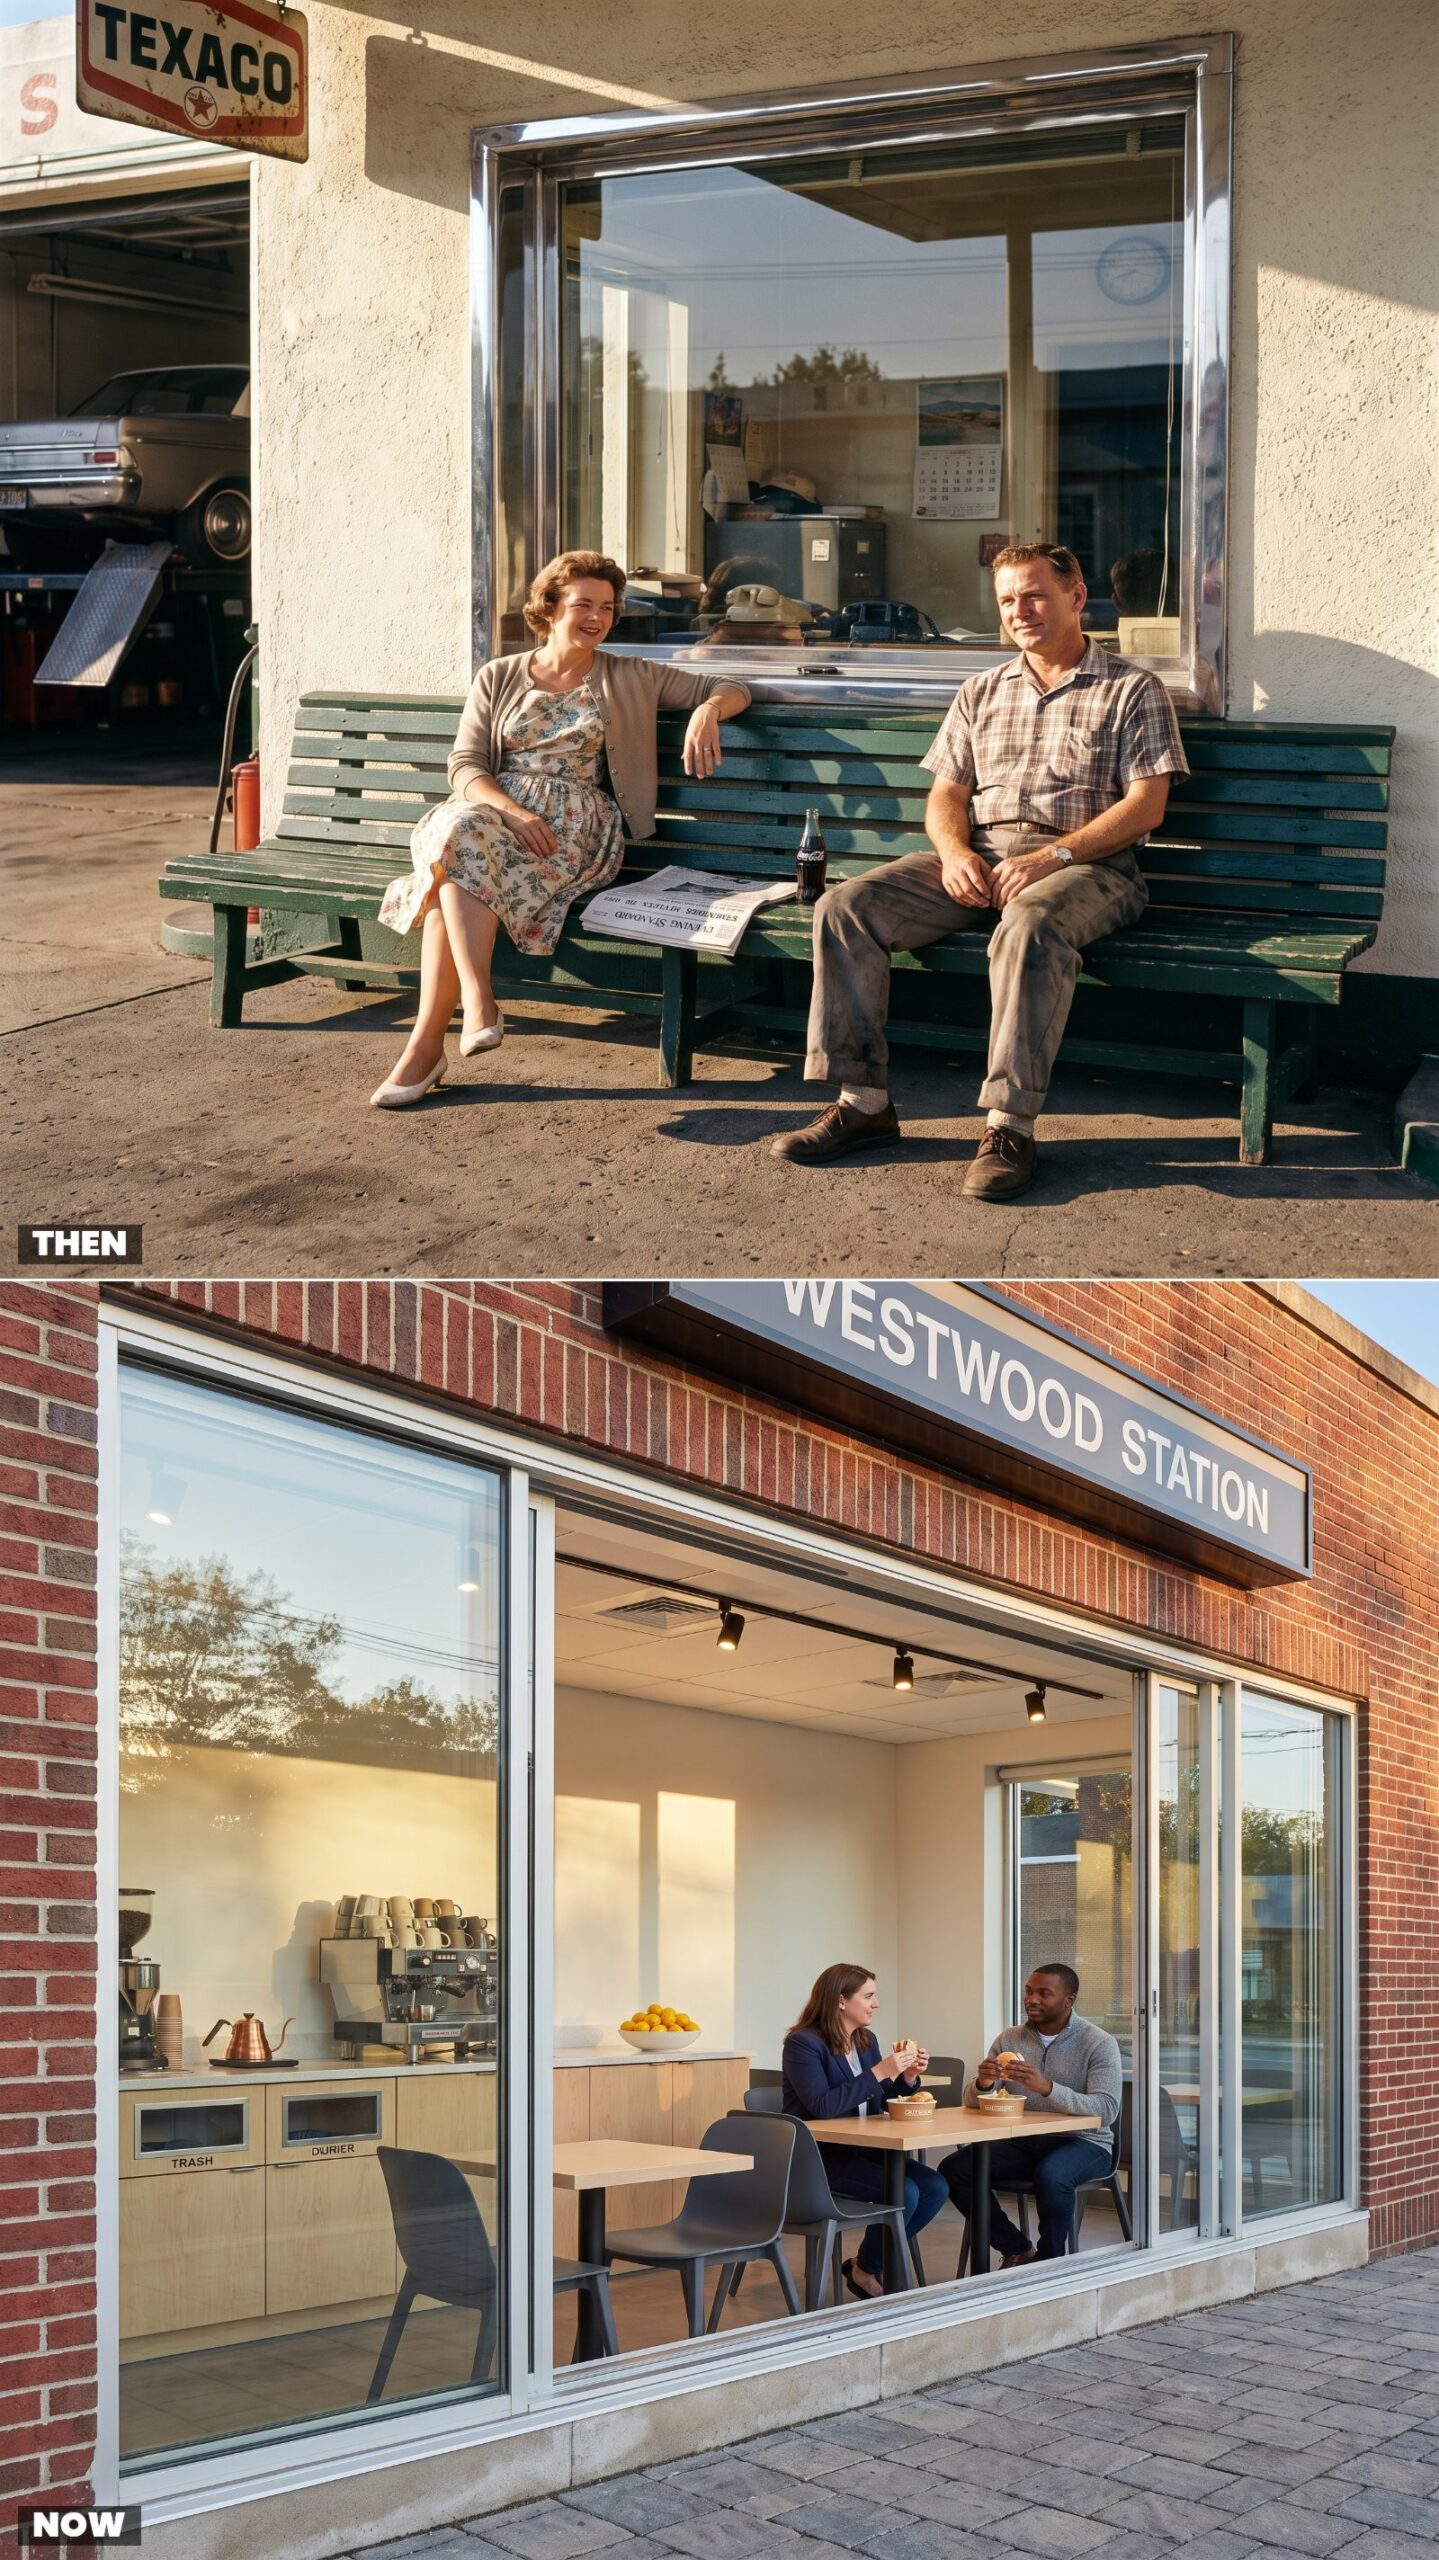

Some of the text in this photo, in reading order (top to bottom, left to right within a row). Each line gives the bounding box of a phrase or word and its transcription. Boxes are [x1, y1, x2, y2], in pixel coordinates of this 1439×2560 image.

[95, 2, 292, 105] TEXACO
[20, 73, 58, 135] S
[614, 911, 666, 928] STANDARD
[781, 1281, 1269, 1535] WESTWOOD STATION
[171, 2156, 213, 2169] TRASH
